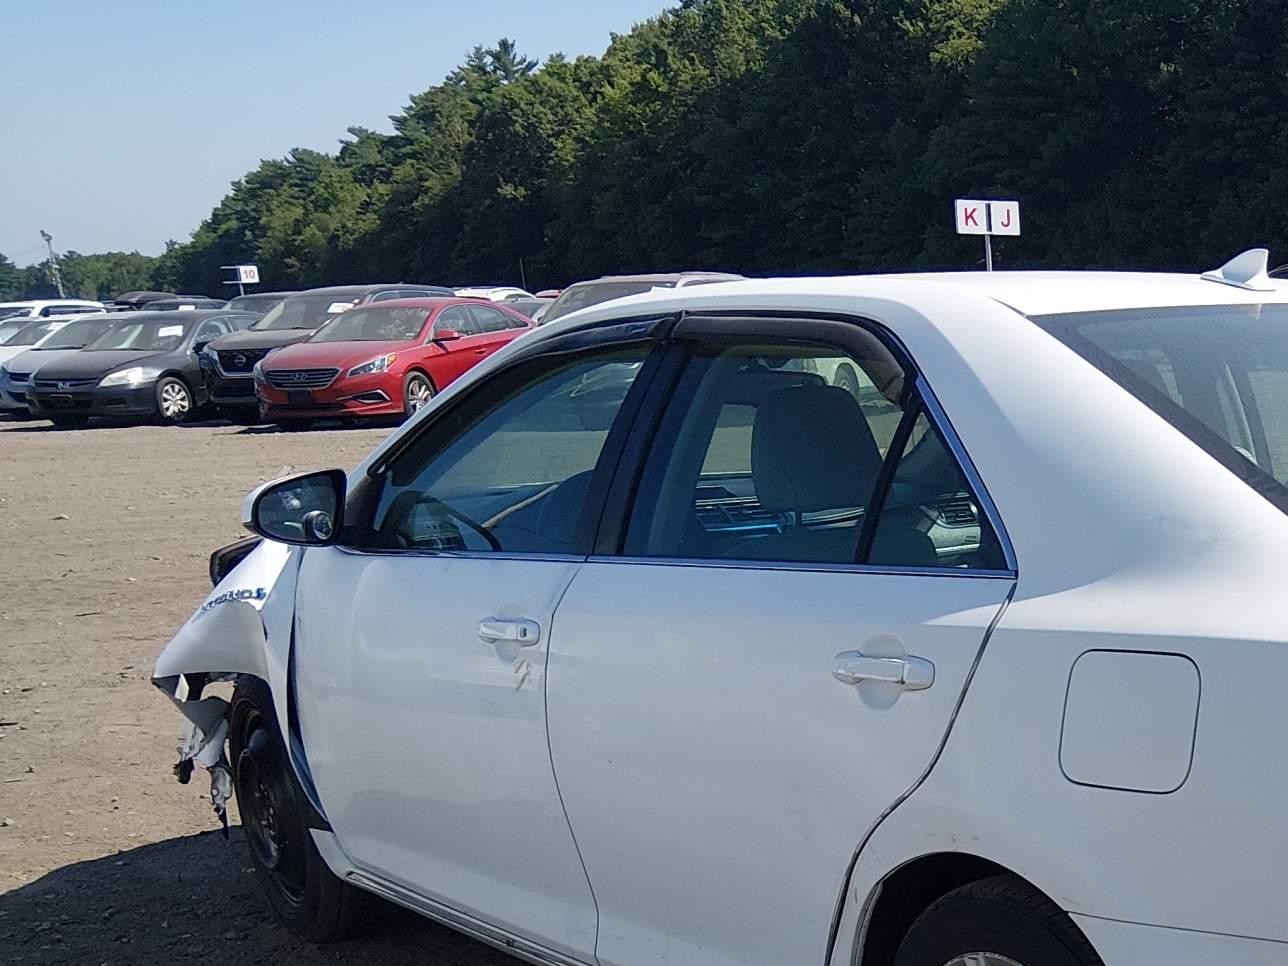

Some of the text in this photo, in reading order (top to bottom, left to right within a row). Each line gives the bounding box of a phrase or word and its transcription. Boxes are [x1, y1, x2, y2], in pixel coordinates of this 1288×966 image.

[964, 207, 1010, 228] K J
[243, 269, 256, 280] 10
